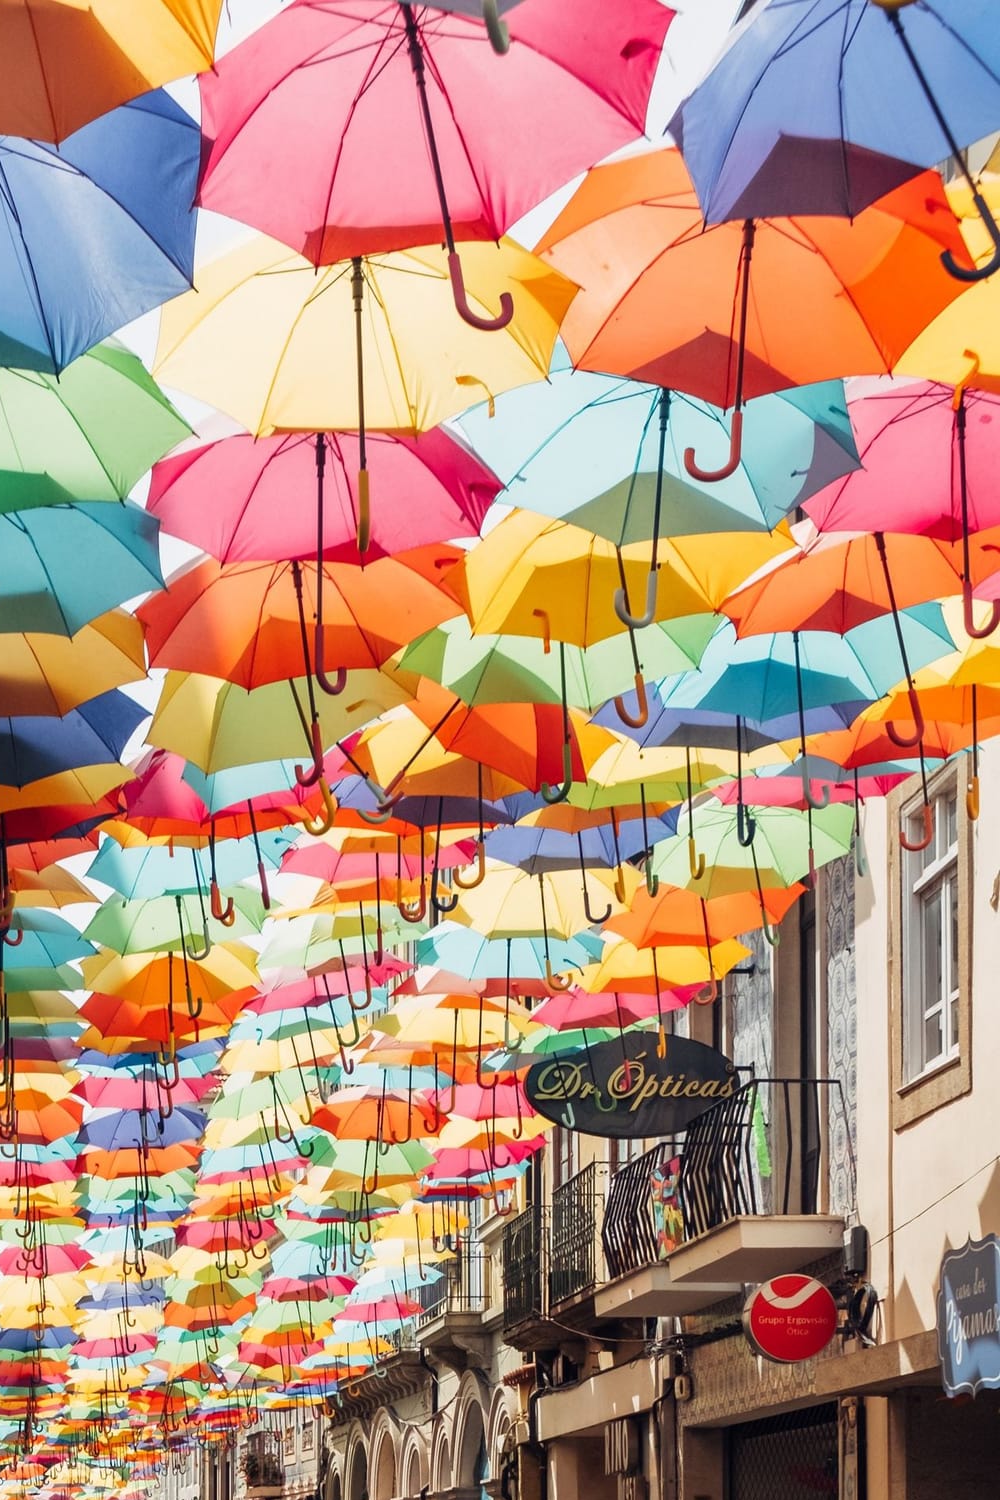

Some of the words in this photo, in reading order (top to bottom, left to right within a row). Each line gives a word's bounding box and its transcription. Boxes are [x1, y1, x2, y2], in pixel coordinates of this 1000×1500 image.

[607, 1051, 735, 1112] Ópticas
[955, 1287, 971, 1301] casa
[973, 1267, 987, 1296] dos
[758, 1315, 785, 1325] Grupo
[787, 1315, 829, 1325] Ergovisão
[786, 1327, 809, 1336] Ótica
